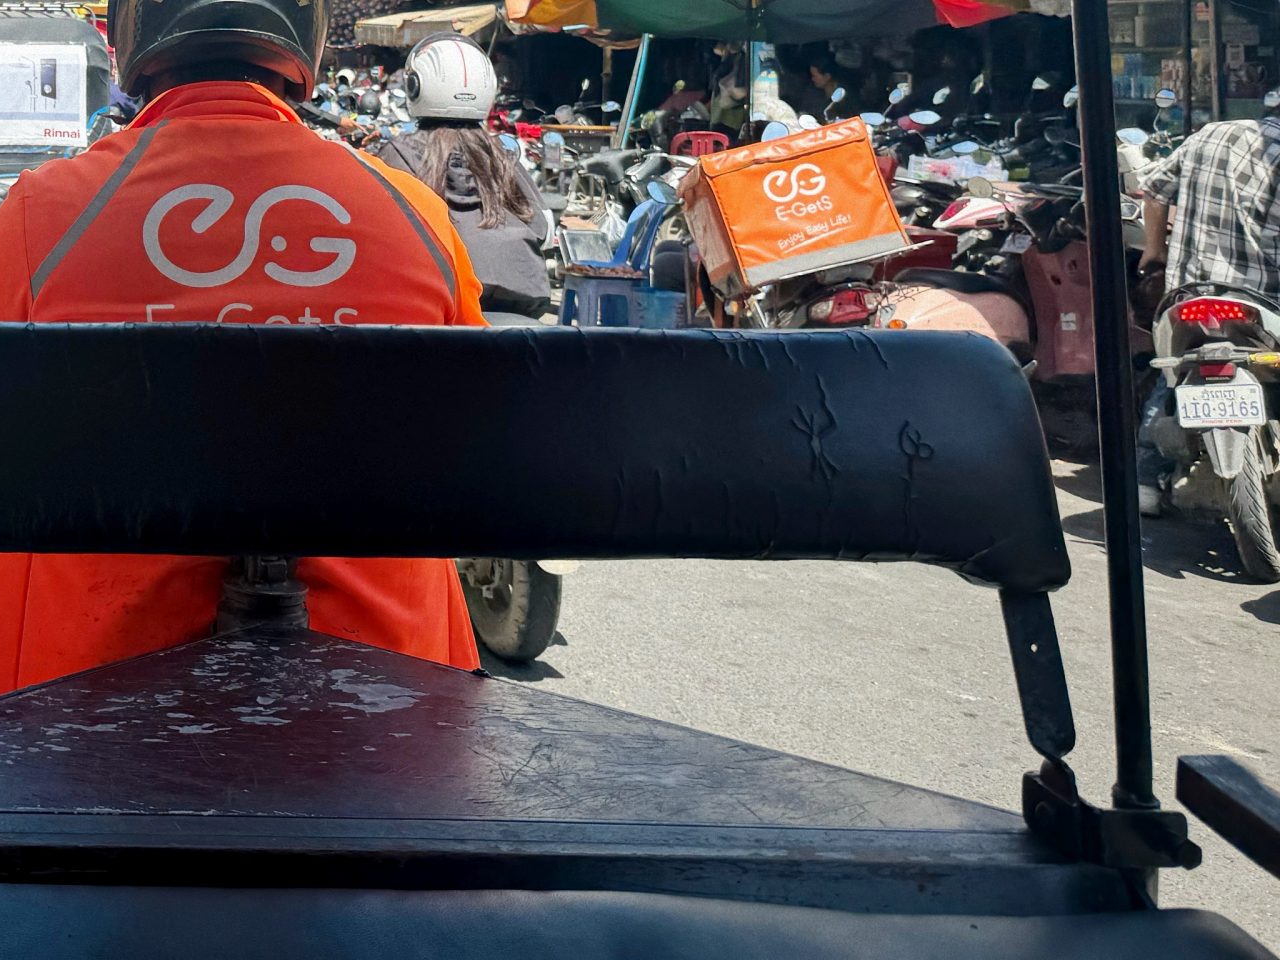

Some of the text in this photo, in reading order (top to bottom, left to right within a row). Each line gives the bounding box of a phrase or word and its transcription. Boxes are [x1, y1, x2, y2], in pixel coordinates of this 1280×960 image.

[44, 128, 81, 139] Rinnai
[777, 213, 852, 250] Enjoy Easy Life!
